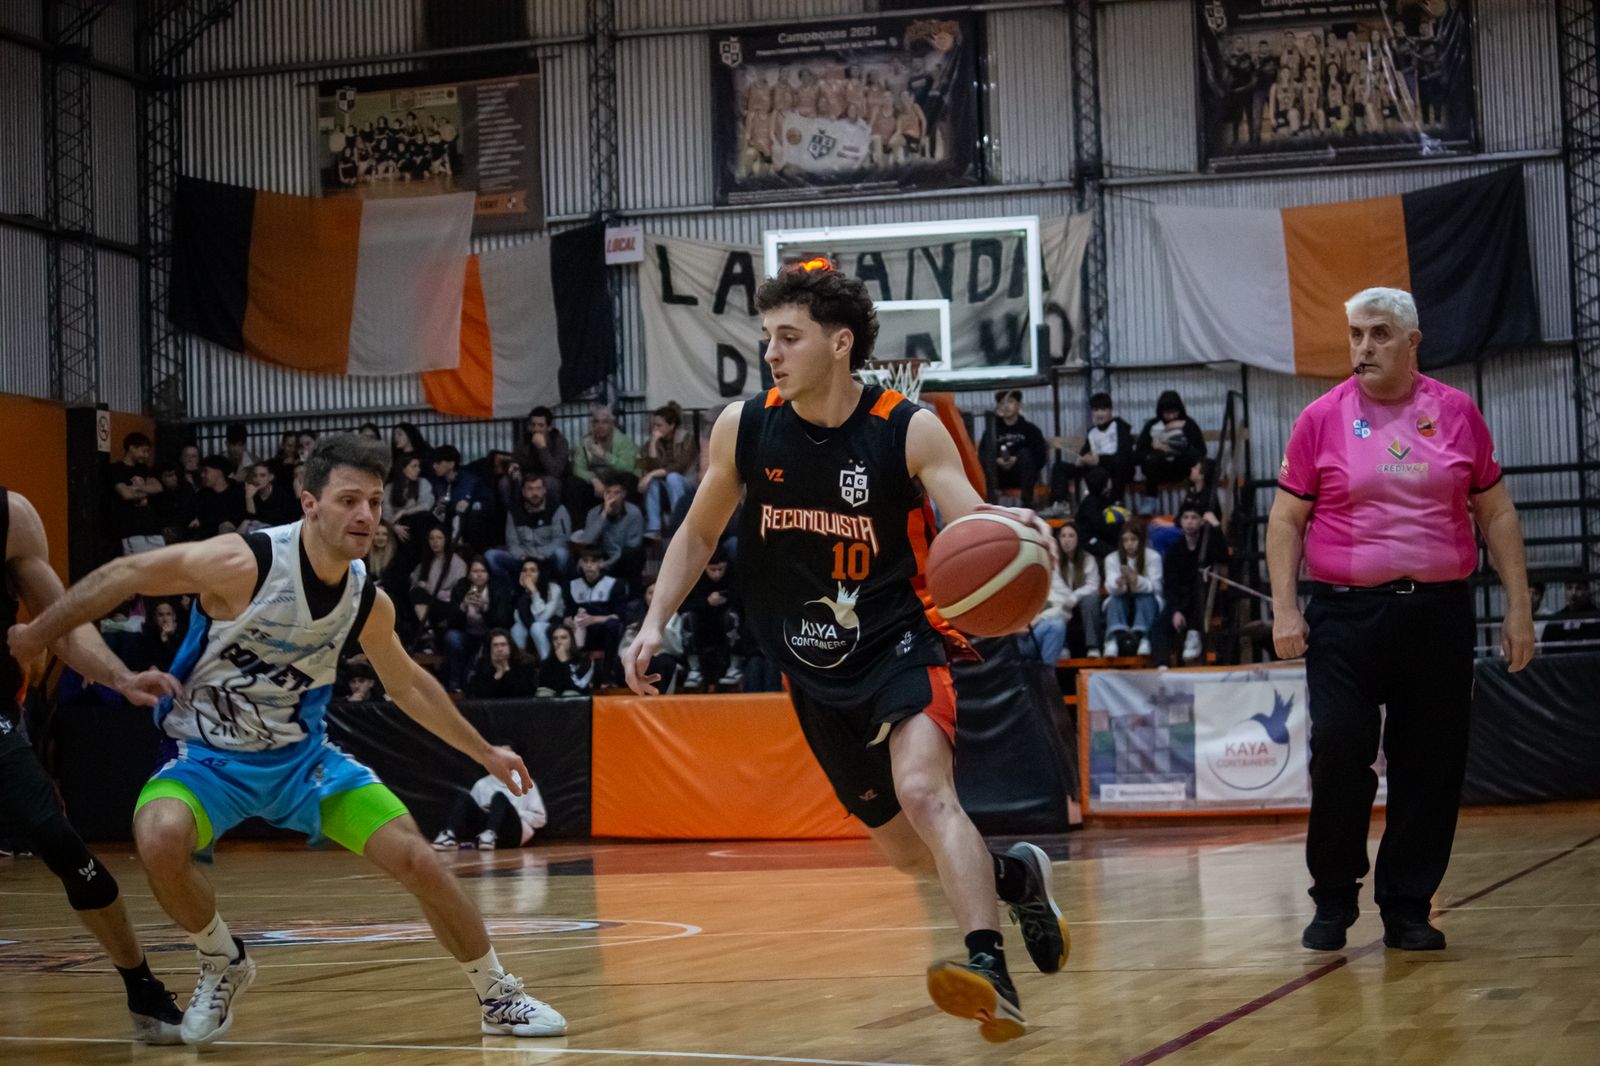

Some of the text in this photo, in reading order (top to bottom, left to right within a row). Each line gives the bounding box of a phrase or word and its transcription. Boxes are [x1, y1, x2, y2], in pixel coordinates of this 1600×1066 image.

[777, 26, 878, 44] Campeonas 2021
[606, 236, 636, 253] LOCAL
[655, 244, 760, 316] LA
[760, 503, 880, 558] RECONQUISTA
[831, 541, 870, 581] 10
[1225, 742, 1269, 757] KAYA
[1216, 757, 1278, 769] CONTAINERS
